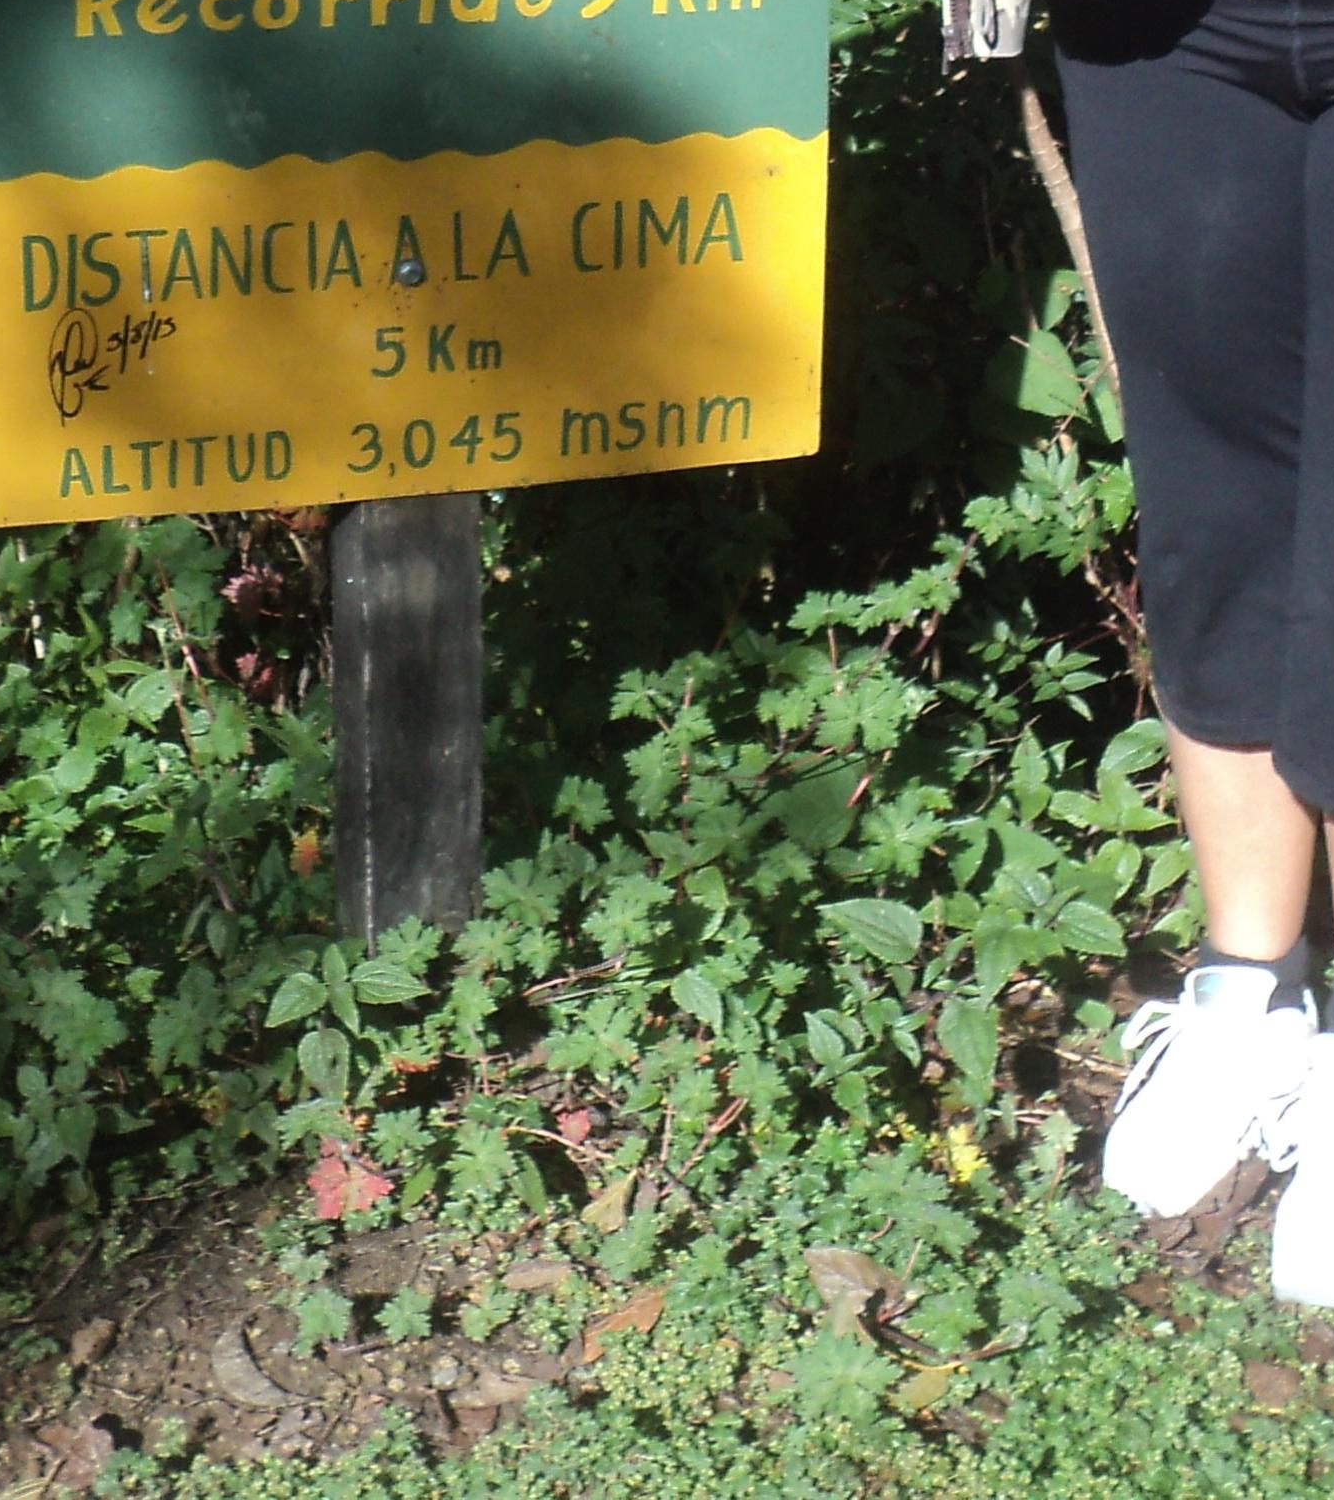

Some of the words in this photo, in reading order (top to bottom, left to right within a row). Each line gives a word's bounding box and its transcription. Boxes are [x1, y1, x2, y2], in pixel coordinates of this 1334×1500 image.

[22, 217, 362, 312] DISTANCIA
[390, 215, 427, 286] A
[453, 209, 529, 281] LA
[570, 191, 745, 273] CIMA
[371, 327, 405, 378] 5
[426, 324, 503, 375] Km
[59, 429, 293, 497] ALTITUD
[347, 412, 523, 478] 3,045
[559, 394, 751, 457] msnm
